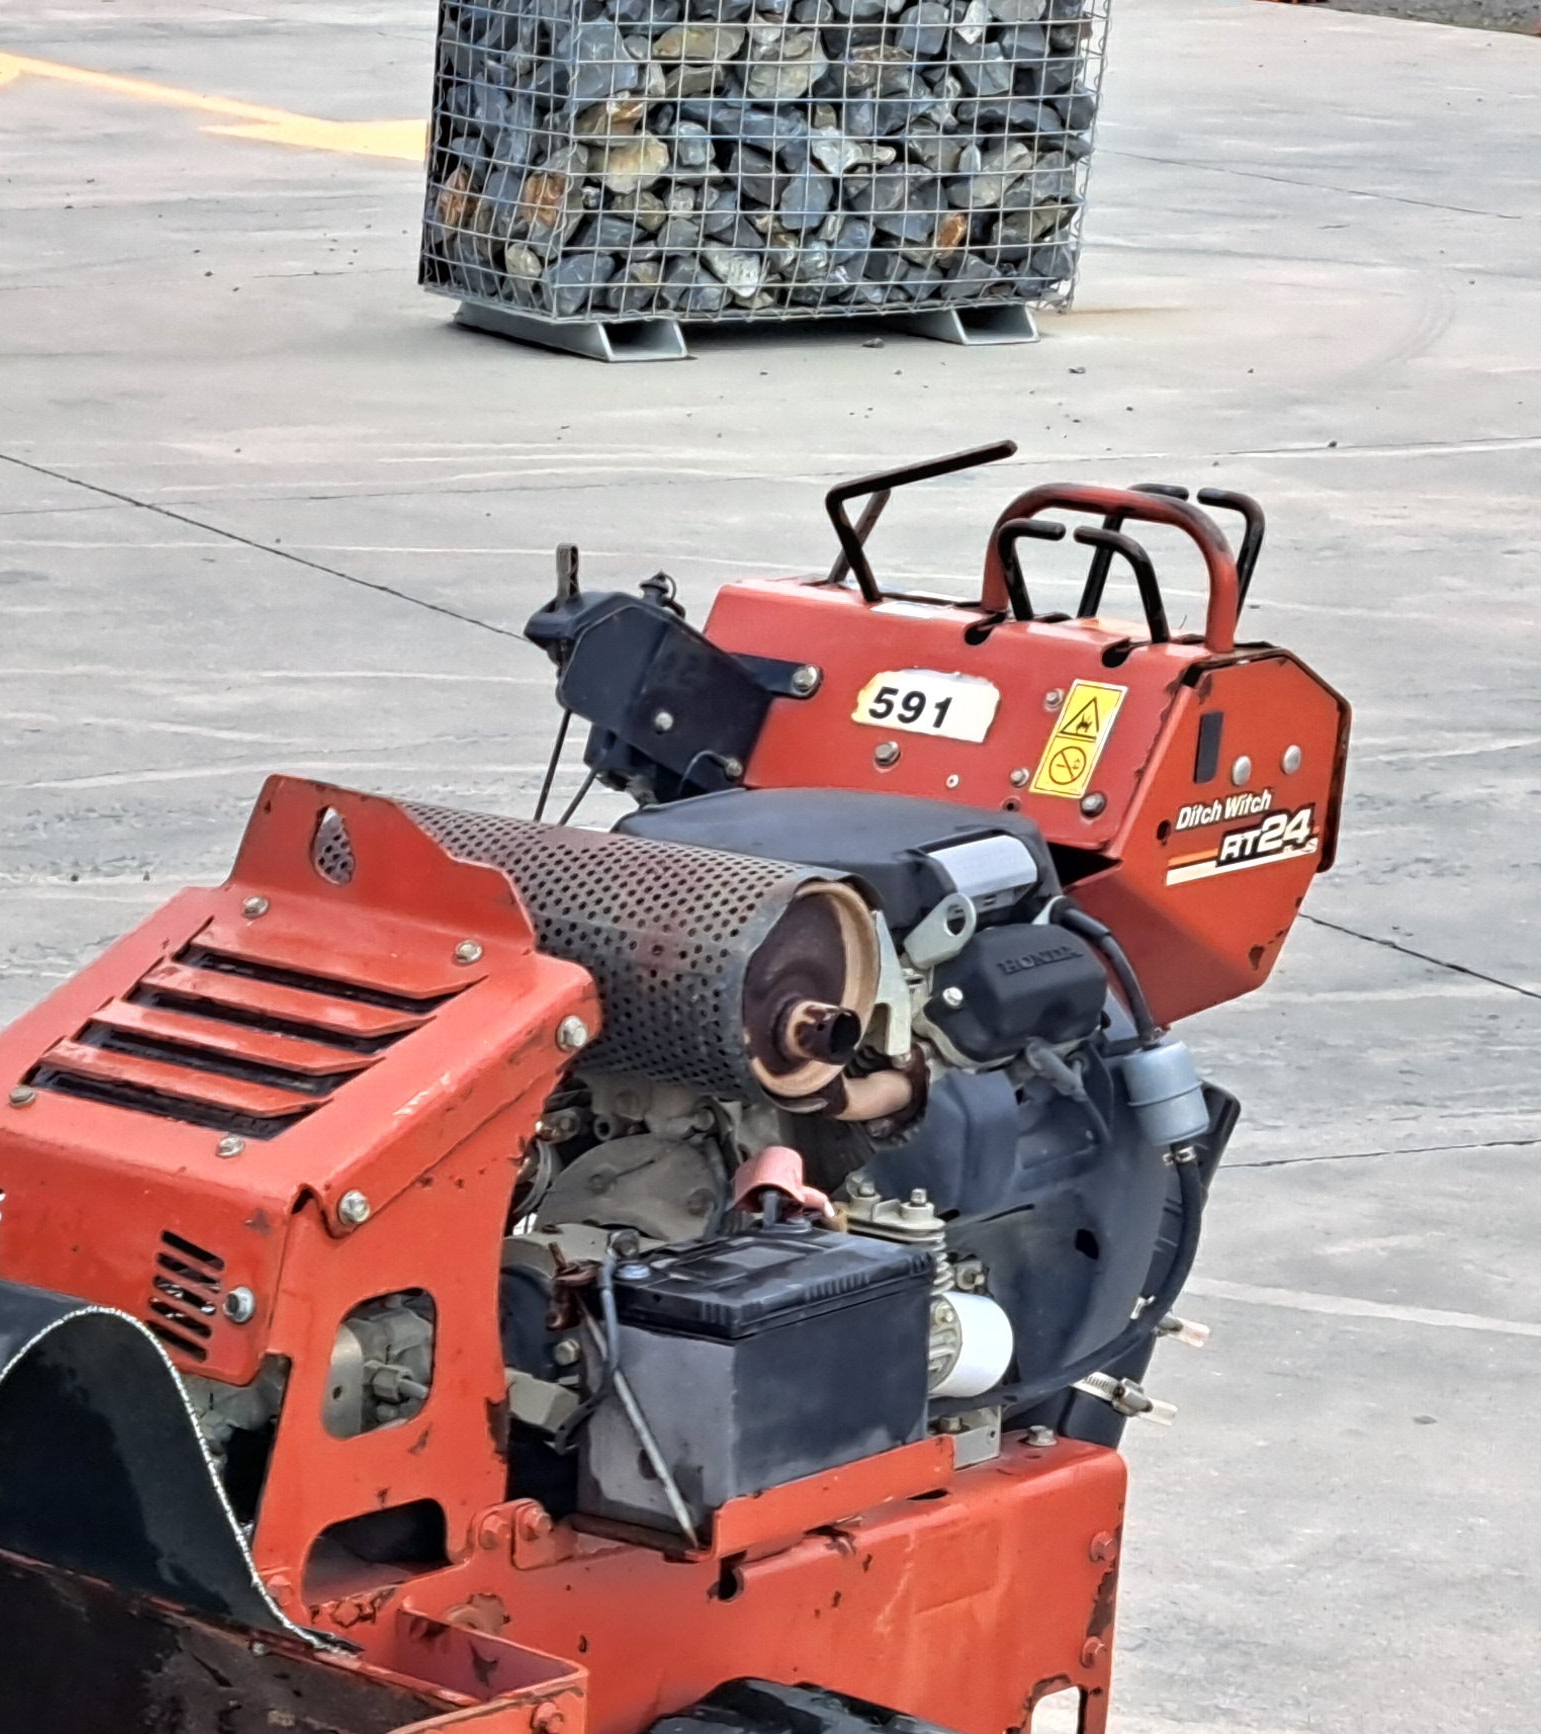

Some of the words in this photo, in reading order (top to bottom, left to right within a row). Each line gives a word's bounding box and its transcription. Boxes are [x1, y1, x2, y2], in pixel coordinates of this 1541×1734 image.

[868, 686, 953, 728] 591
[1175, 799, 1222, 831] Ditch
[1224, 788, 1273, 819] Witch
[1219, 808, 1313, 861] RT24
[997, 946, 1084, 976] HONDA
